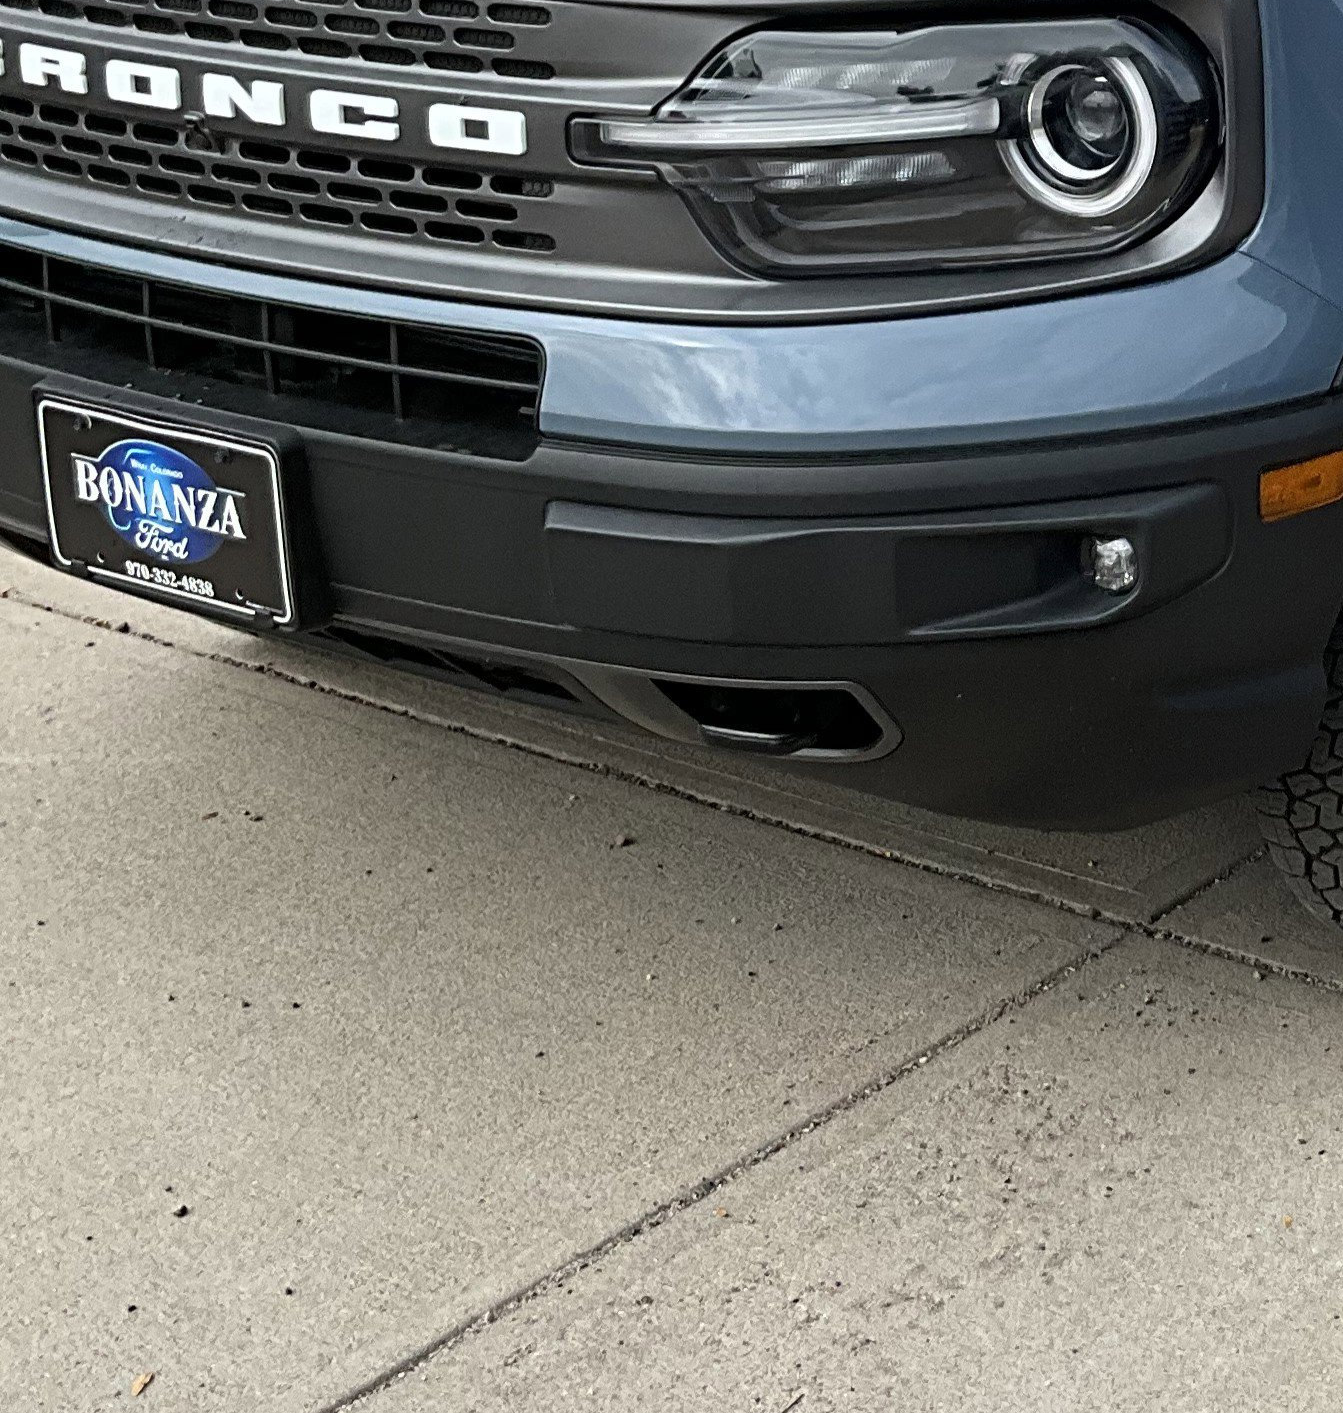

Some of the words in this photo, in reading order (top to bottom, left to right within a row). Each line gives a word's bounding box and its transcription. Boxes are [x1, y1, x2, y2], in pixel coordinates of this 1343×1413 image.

[0, 38, 528, 156] RONCO
[74, 459, 247, 540] BONANZA
[135, 519, 189, 560] Ford
[125, 559, 215, 597] 970-332-4838
